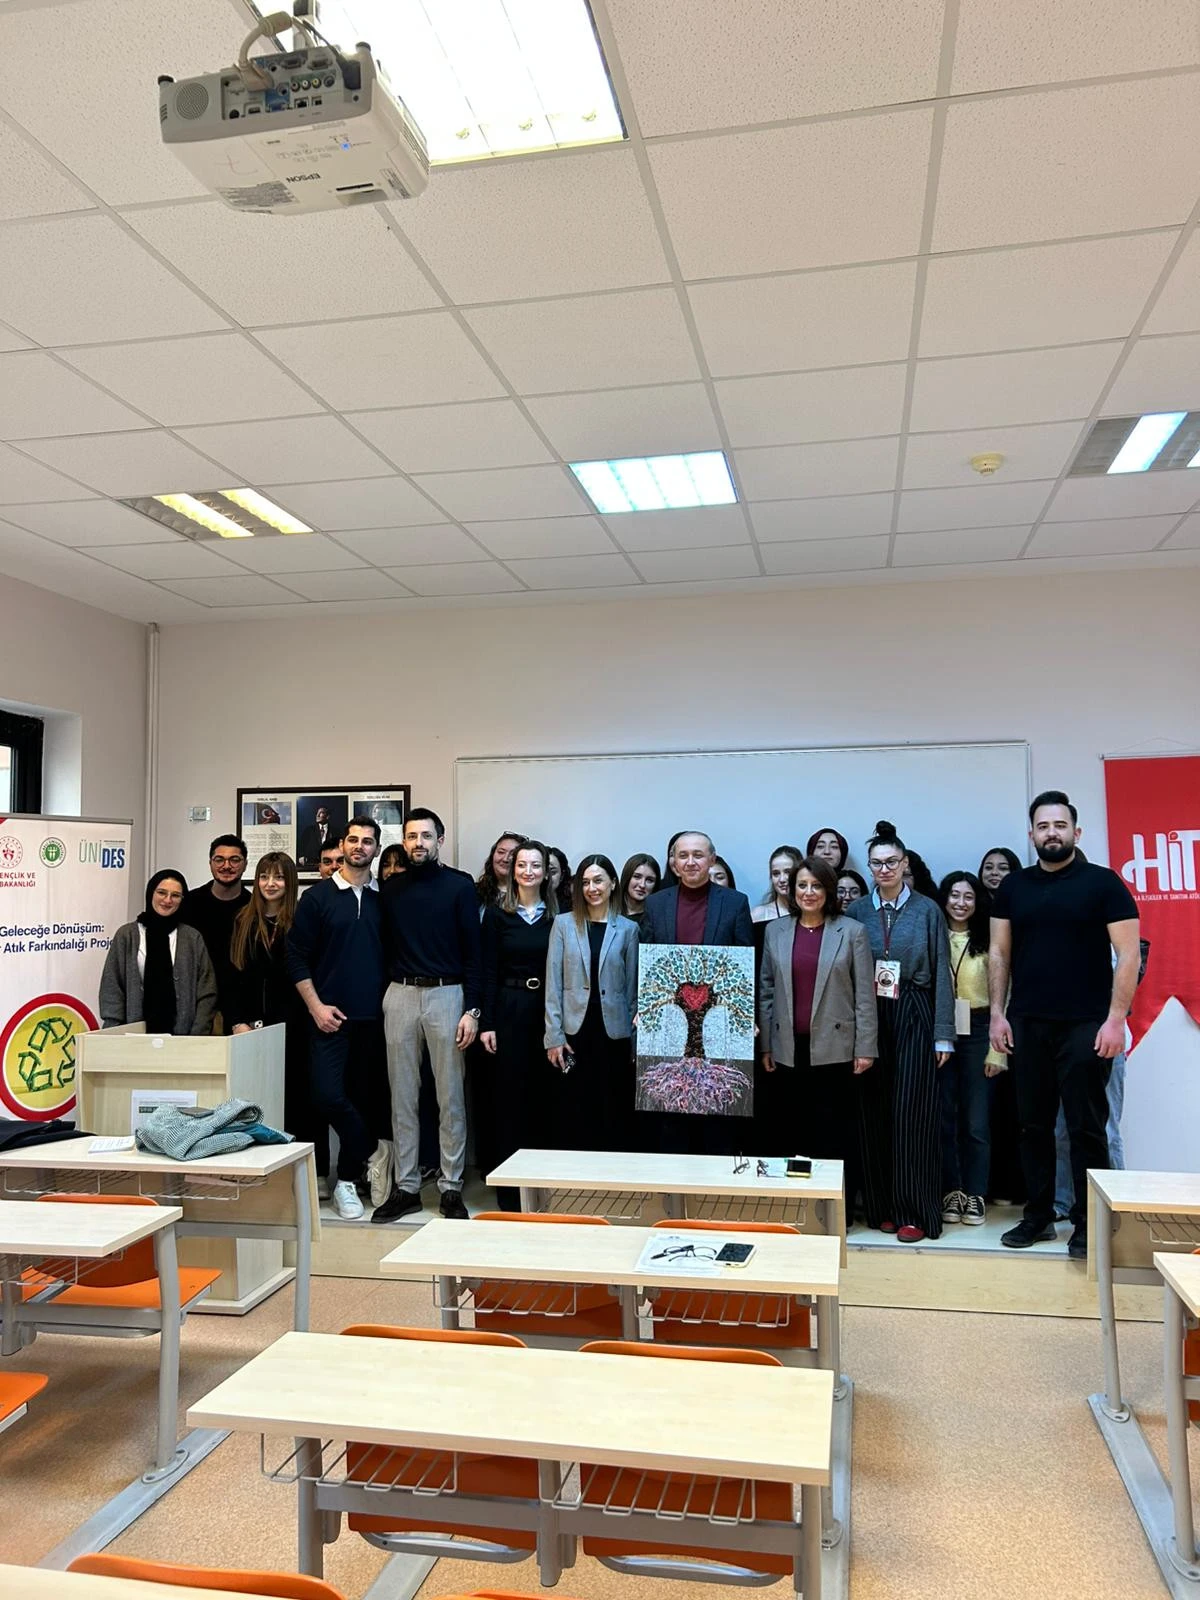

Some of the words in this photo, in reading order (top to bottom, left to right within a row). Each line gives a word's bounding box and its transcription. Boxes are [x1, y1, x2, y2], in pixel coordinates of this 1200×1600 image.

[286, 173, 321, 183] EPSON
[102, 848, 125, 868] DES
[0, 924, 50, 938] Geleceğe
[53, 923, 105, 937] Dönüşüm:
[3, 941, 26, 954] Atık
[28, 938, 87, 952] Farkındalığı
